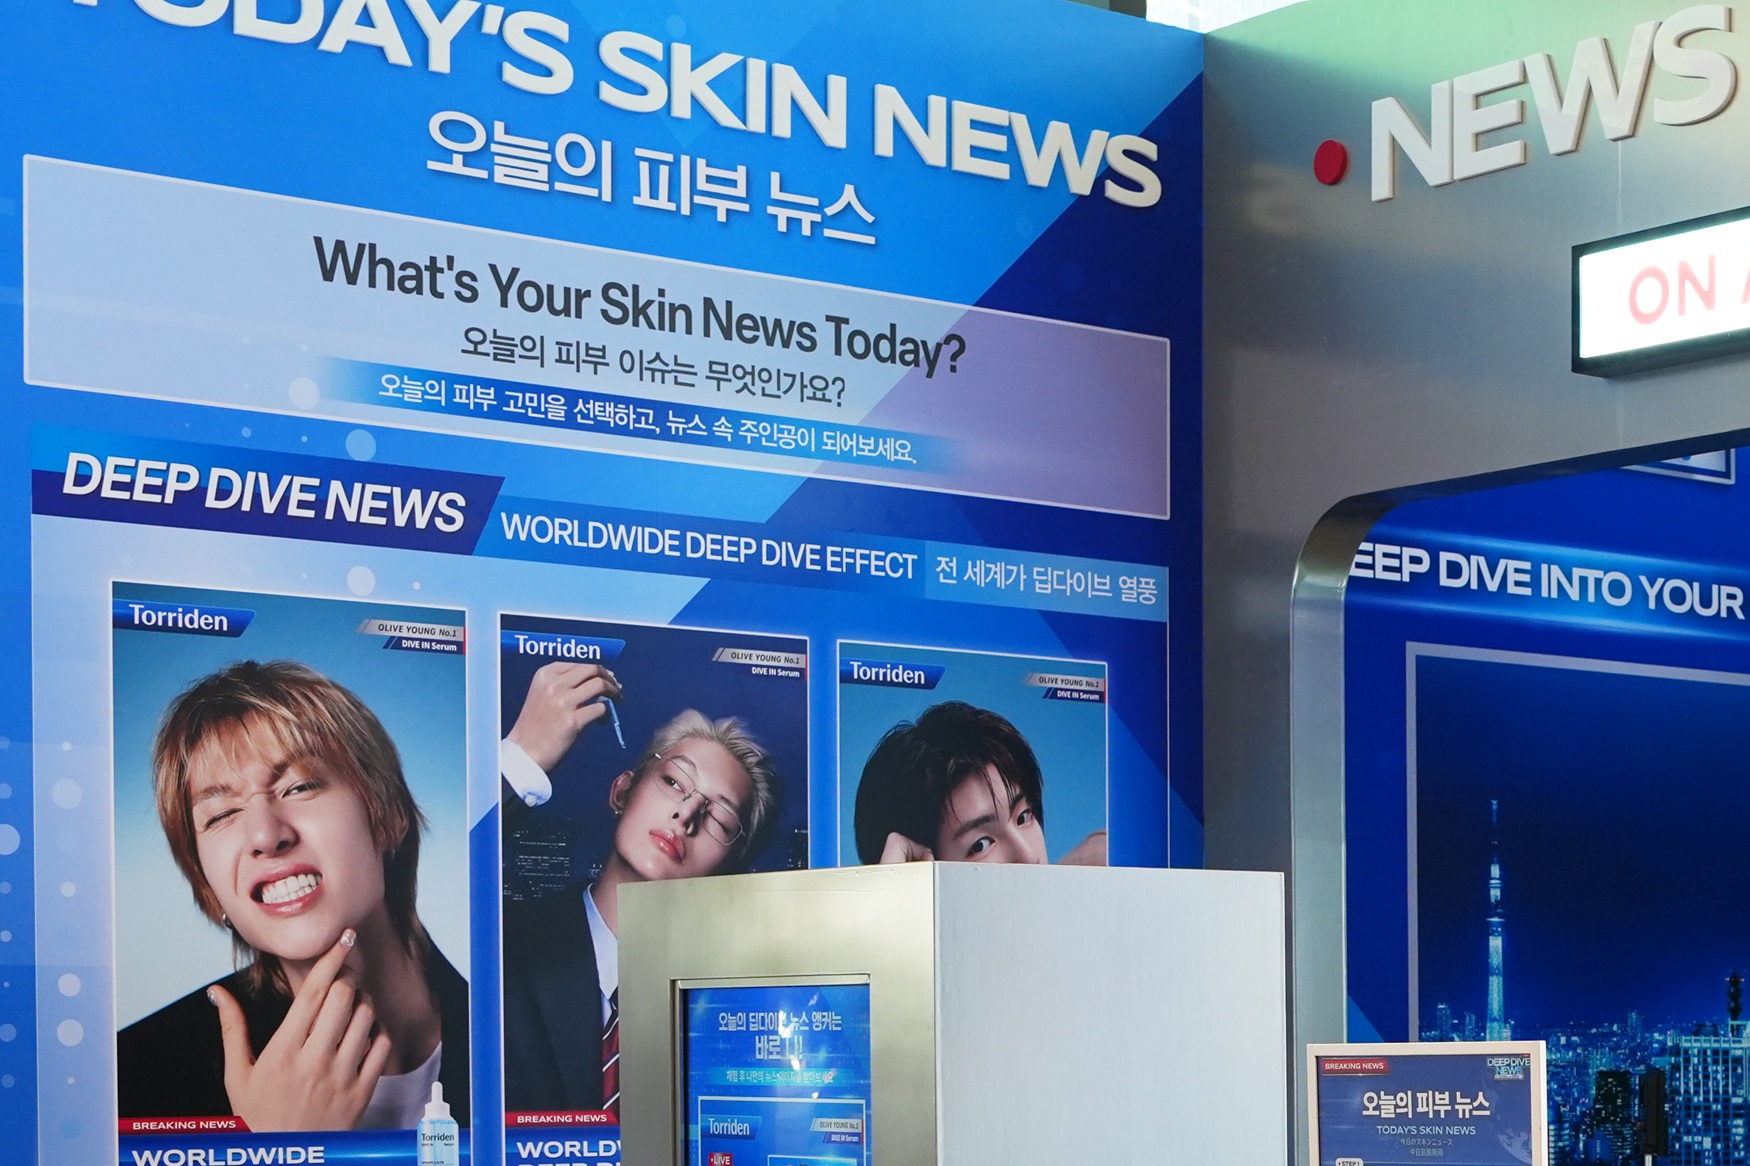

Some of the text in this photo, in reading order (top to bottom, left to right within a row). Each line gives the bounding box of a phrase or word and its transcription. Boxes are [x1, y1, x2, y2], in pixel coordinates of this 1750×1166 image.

[73, 0, 1162, 208] AY'S SKIN NEWS
[1370, 4, 1738, 203] NEWS
[426, 110, 876, 246] 오늘의 피부 뉴스
[312, 236, 966, 379] What's Your Skin News Today?
[1628, 264, 1717, 327] ON
[460, 326, 846, 408] 오늘의 피부 이슈는 무엇인가요?
[379, 373, 917, 466] 오늘의 피부 고민을 선택하고, 뉴스 속 주인공이 되어보세요.
[62, 452, 468, 534] DEEP DIVE NEWS
[500, 512, 918, 580] WORLDWIDE DEEP DIVE EFFECT
[935, 556, 1158, 606] 전 세계가 딥다이브 열풍
[1348, 541, 1431, 583] EEP
[1438, 550, 1532, 600] DIVE
[1540, 562, 1633, 608] INTO
[1637, 573, 1746, 622] YOUR
[128, 603, 229, 632] Torriden
[377, 622, 458, 638] OLIVE YOUNG No.1
[401, 639, 458, 652] DIVE IN Serum
[514, 634, 601, 661] Torriden
[849, 661, 926, 686] Torriden
[1362, 1062, 1384, 1070] NEWS
[517, 1114, 607, 1124] BREAKING NEWS
[1362, 1090, 1491, 1119] 오늘의 피부 뉴스
[132, 1120, 237, 1131] BREAKING NEWS
[421, 1133, 455, 1142] Torriden
[708, 1117, 750, 1136] Torriden
[1376, 1126, 1476, 1135] TODAY'S SKIN NEWS
[714, 1155, 730, 1165] LIVE
